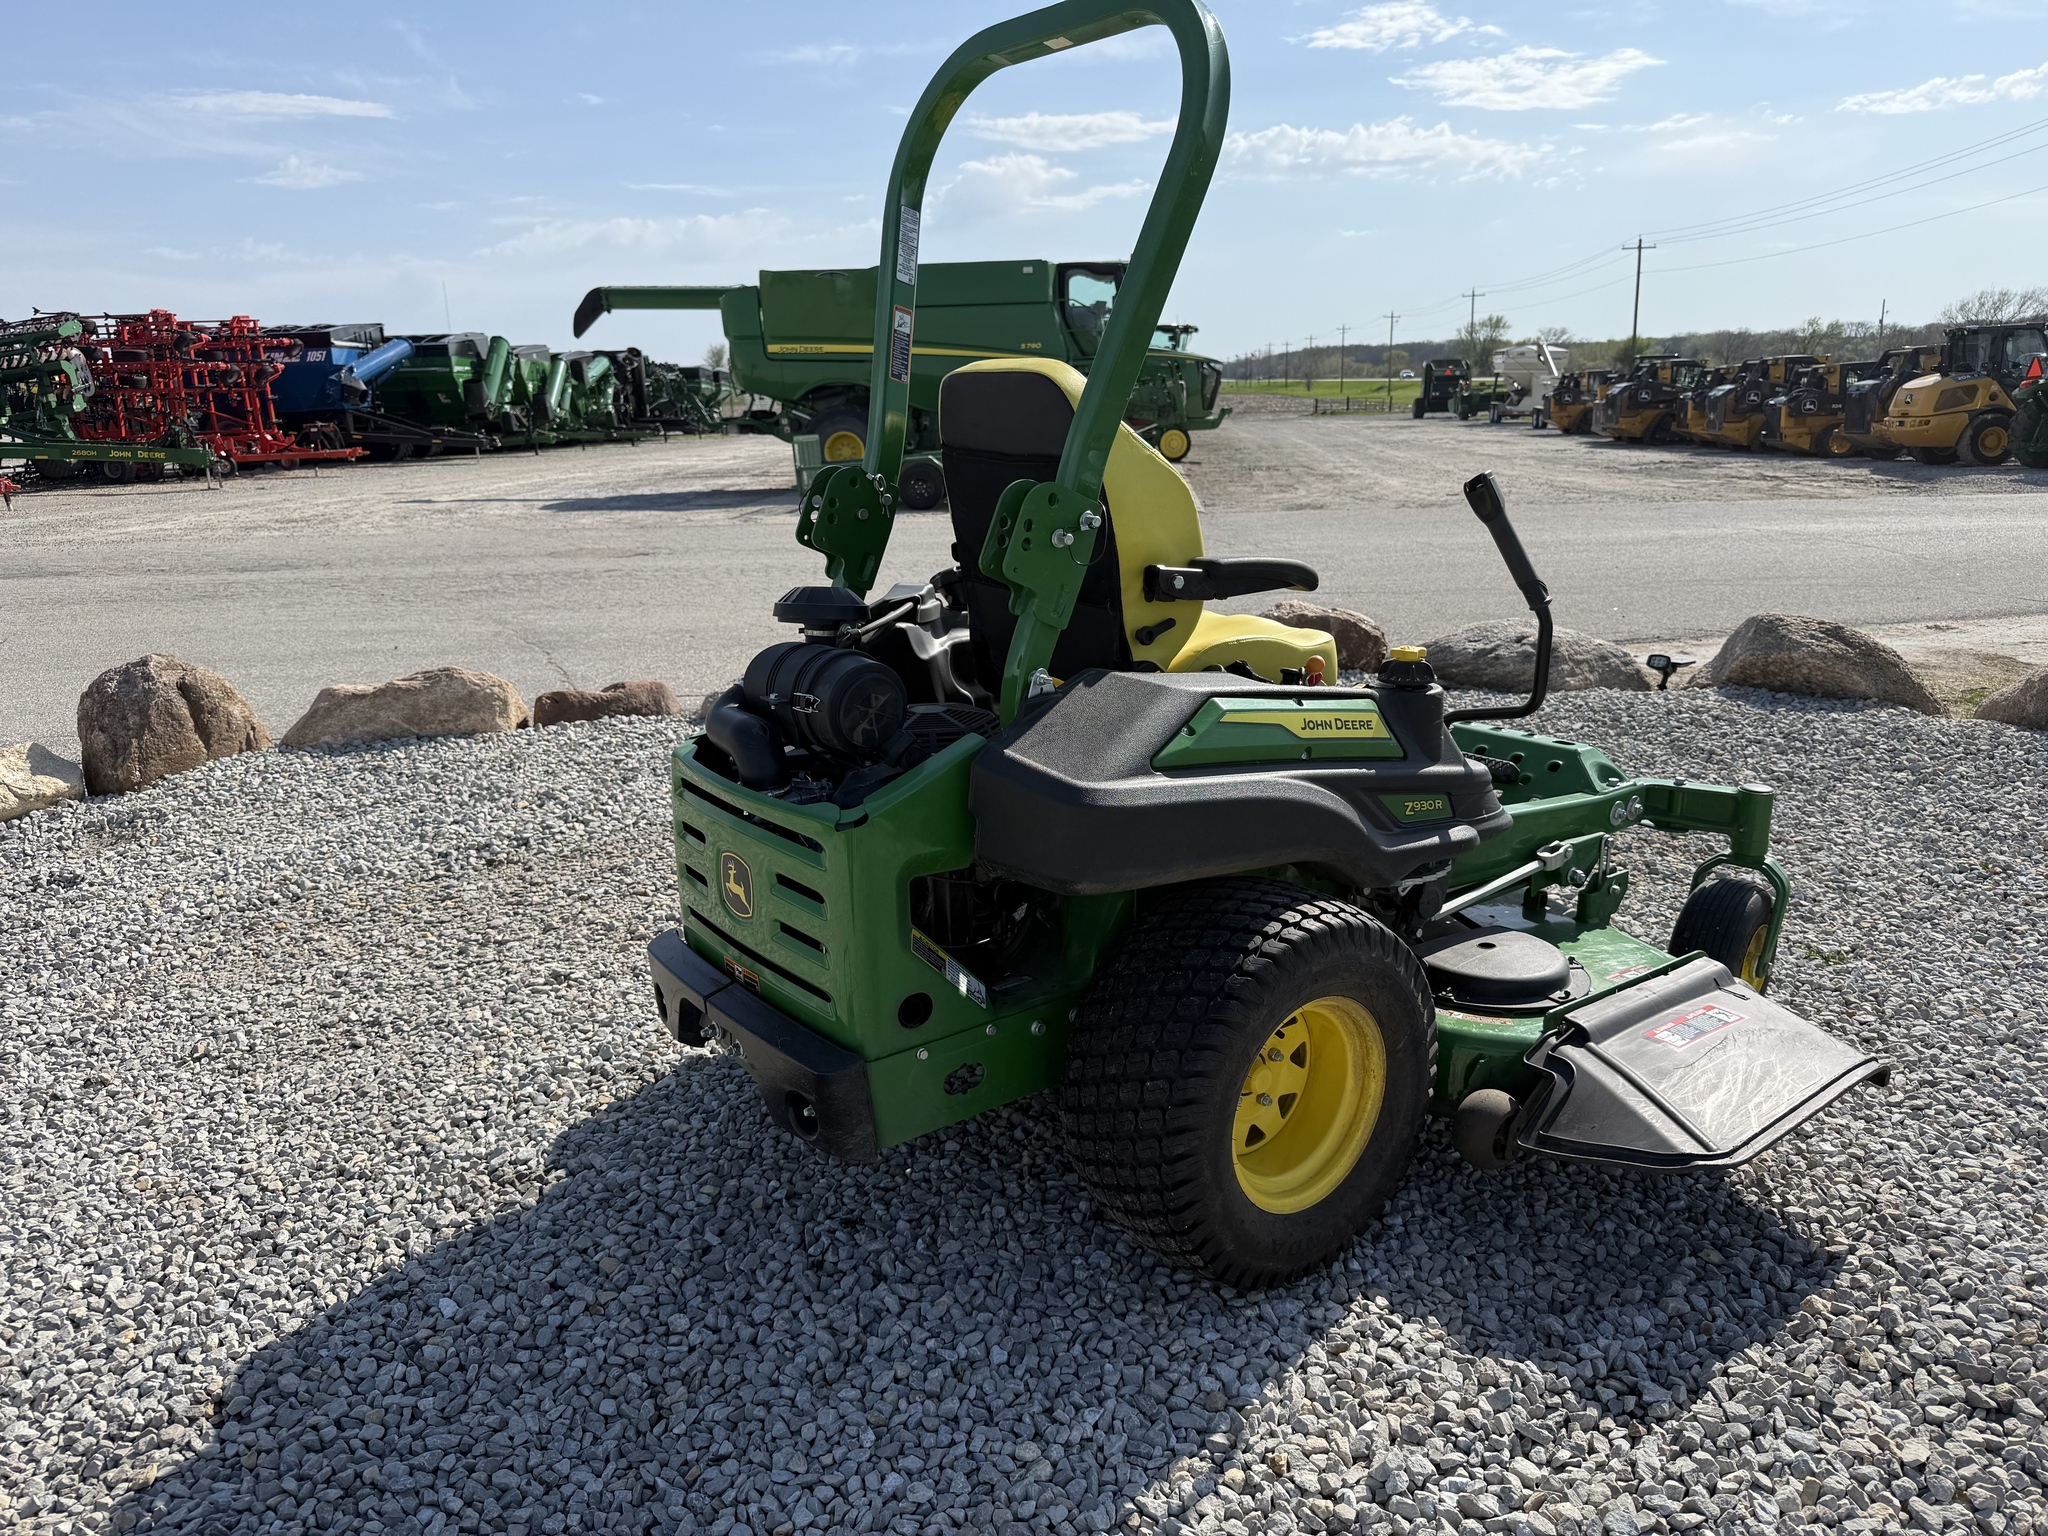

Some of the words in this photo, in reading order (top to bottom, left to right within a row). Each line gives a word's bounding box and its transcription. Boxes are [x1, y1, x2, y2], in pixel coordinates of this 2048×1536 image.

[306, 350, 327, 362] 1051
[109, 449, 132, 458] JOHN
[137, 450, 166, 459] DEERE
[1301, 717, 1333, 731] JOHN
[1334, 717, 1374, 731] DEERE
[1404, 799, 1443, 816] Z930R
